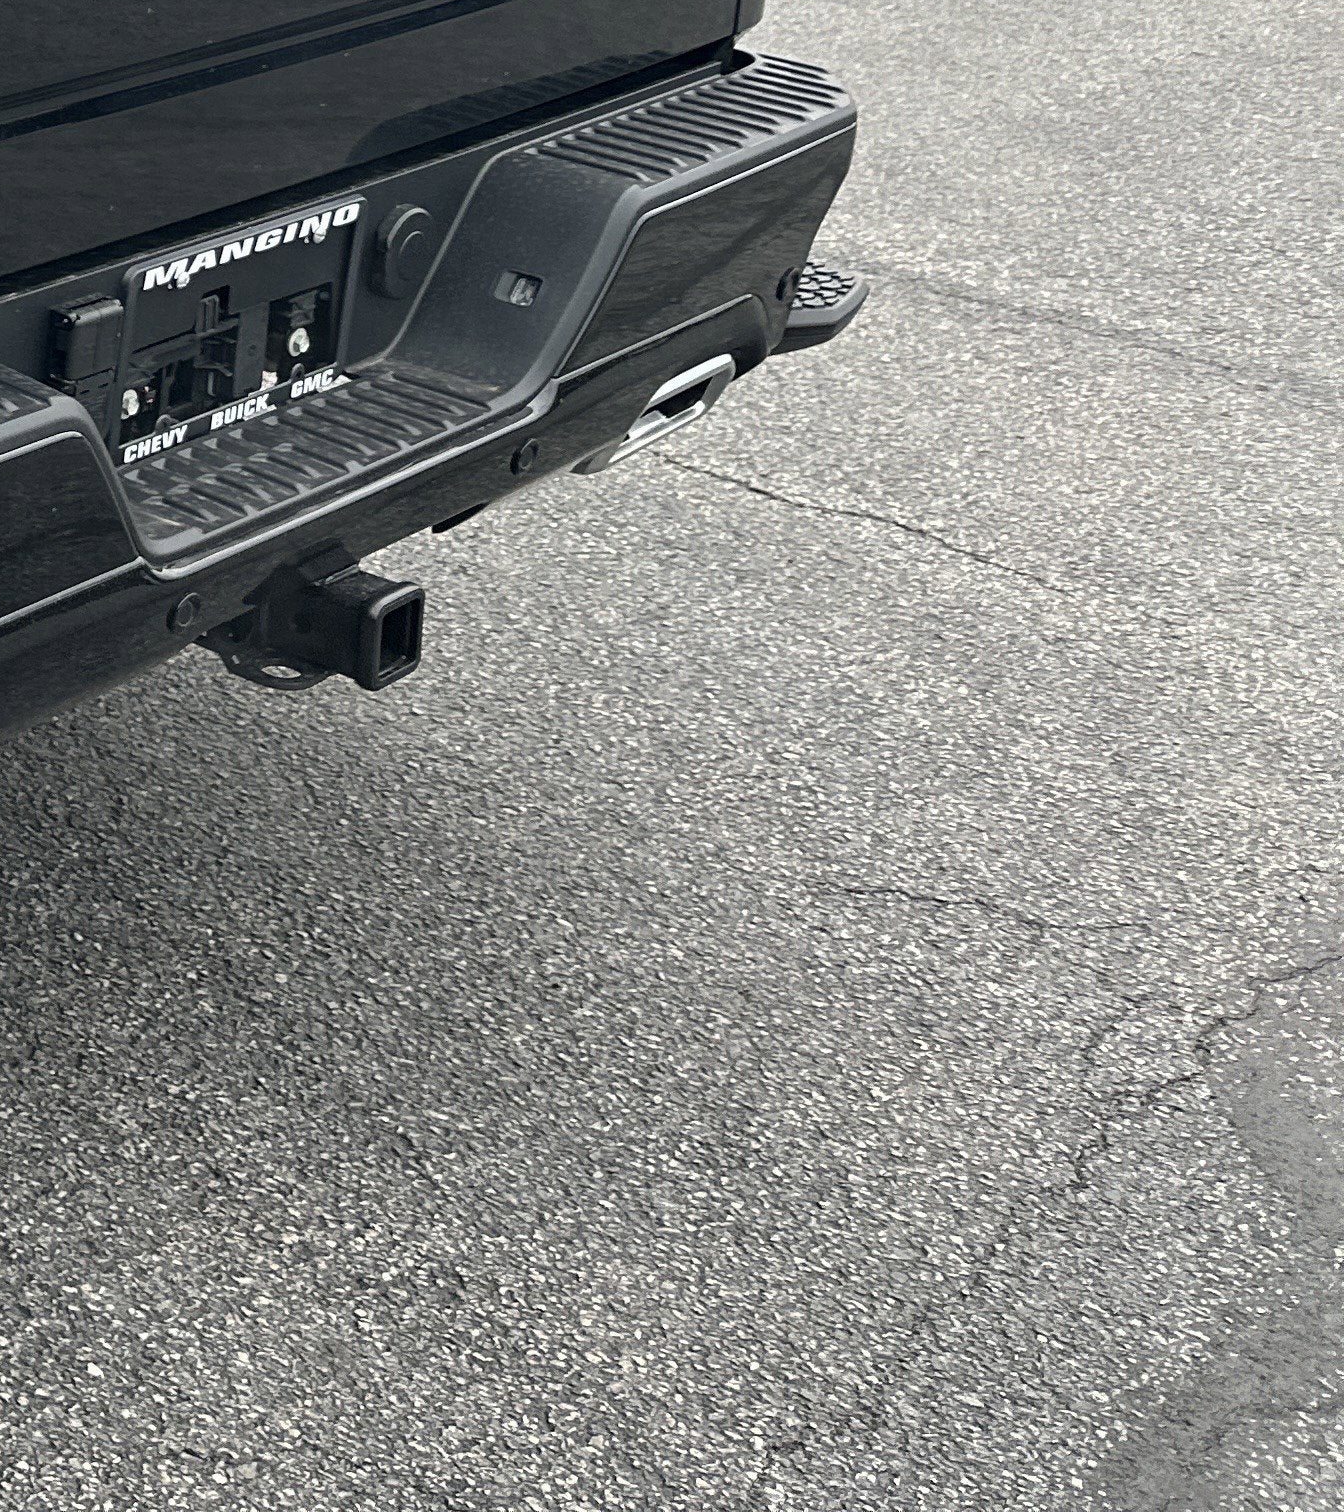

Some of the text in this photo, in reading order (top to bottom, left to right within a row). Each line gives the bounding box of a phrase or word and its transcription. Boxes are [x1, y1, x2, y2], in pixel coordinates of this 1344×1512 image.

[142, 202, 361, 291] MANGINO
[123, 368, 334, 464] CHEVY BUICK GMC
